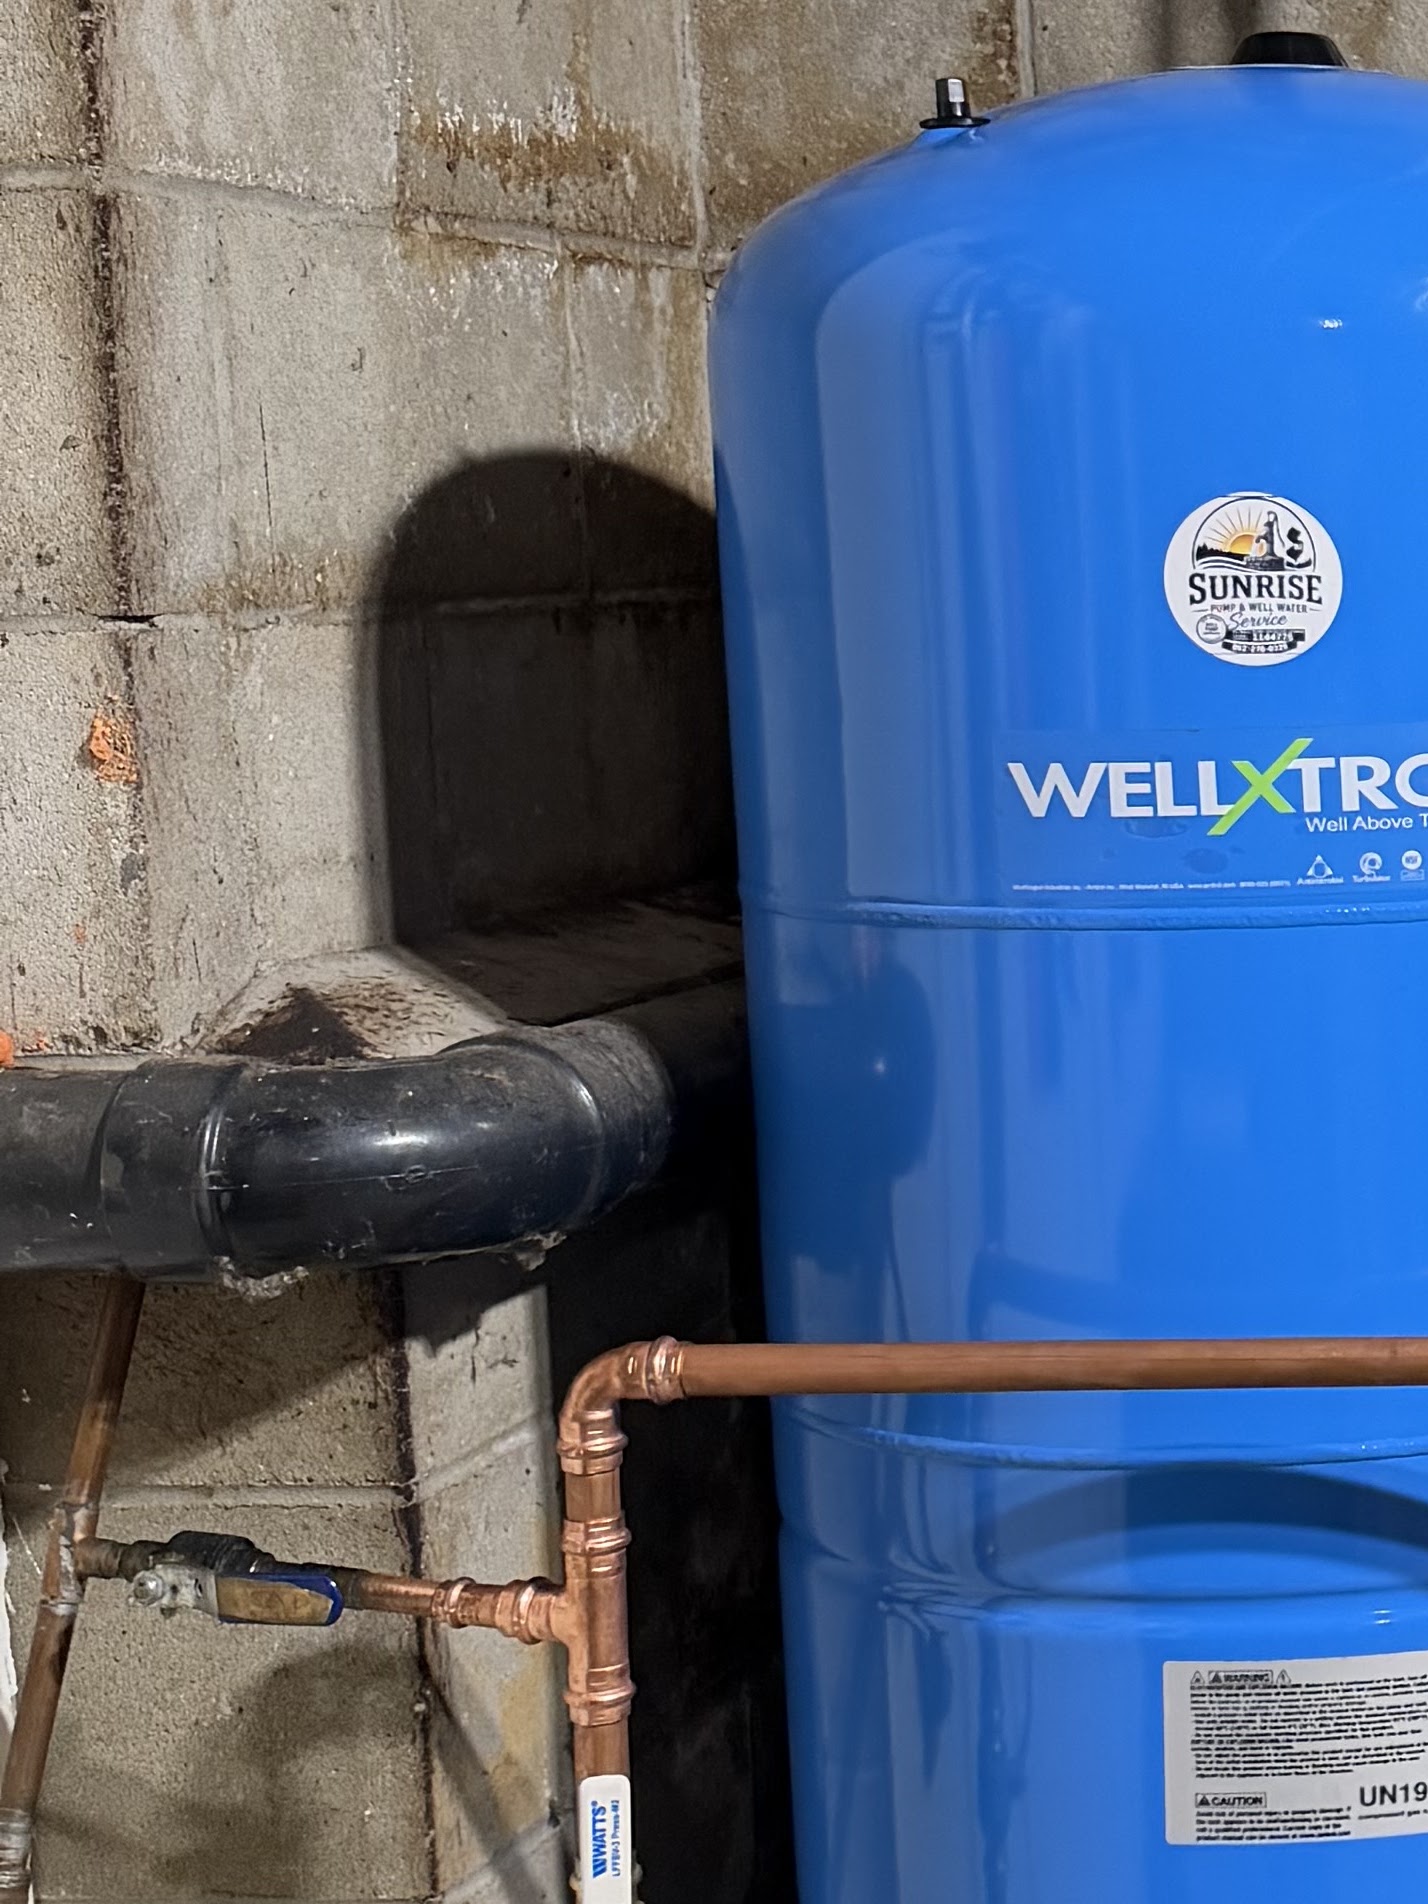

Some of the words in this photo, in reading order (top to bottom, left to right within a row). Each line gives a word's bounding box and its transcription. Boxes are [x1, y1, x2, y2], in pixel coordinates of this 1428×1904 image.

[1188, 572, 1323, 606] SUNRISE
[1210, 604, 1236, 613] PUMP
[1249, 603, 1274, 614] WELL
[1277, 603, 1308, 614] WATER
[1228, 612, 1288, 632] Service
[1305, 817, 1348, 832] Well
[1352, 815, 1413, 831] Above
[1211, 1796, 1264, 1807] CAUTION
[591, 1805, 608, 1858] WATTS
